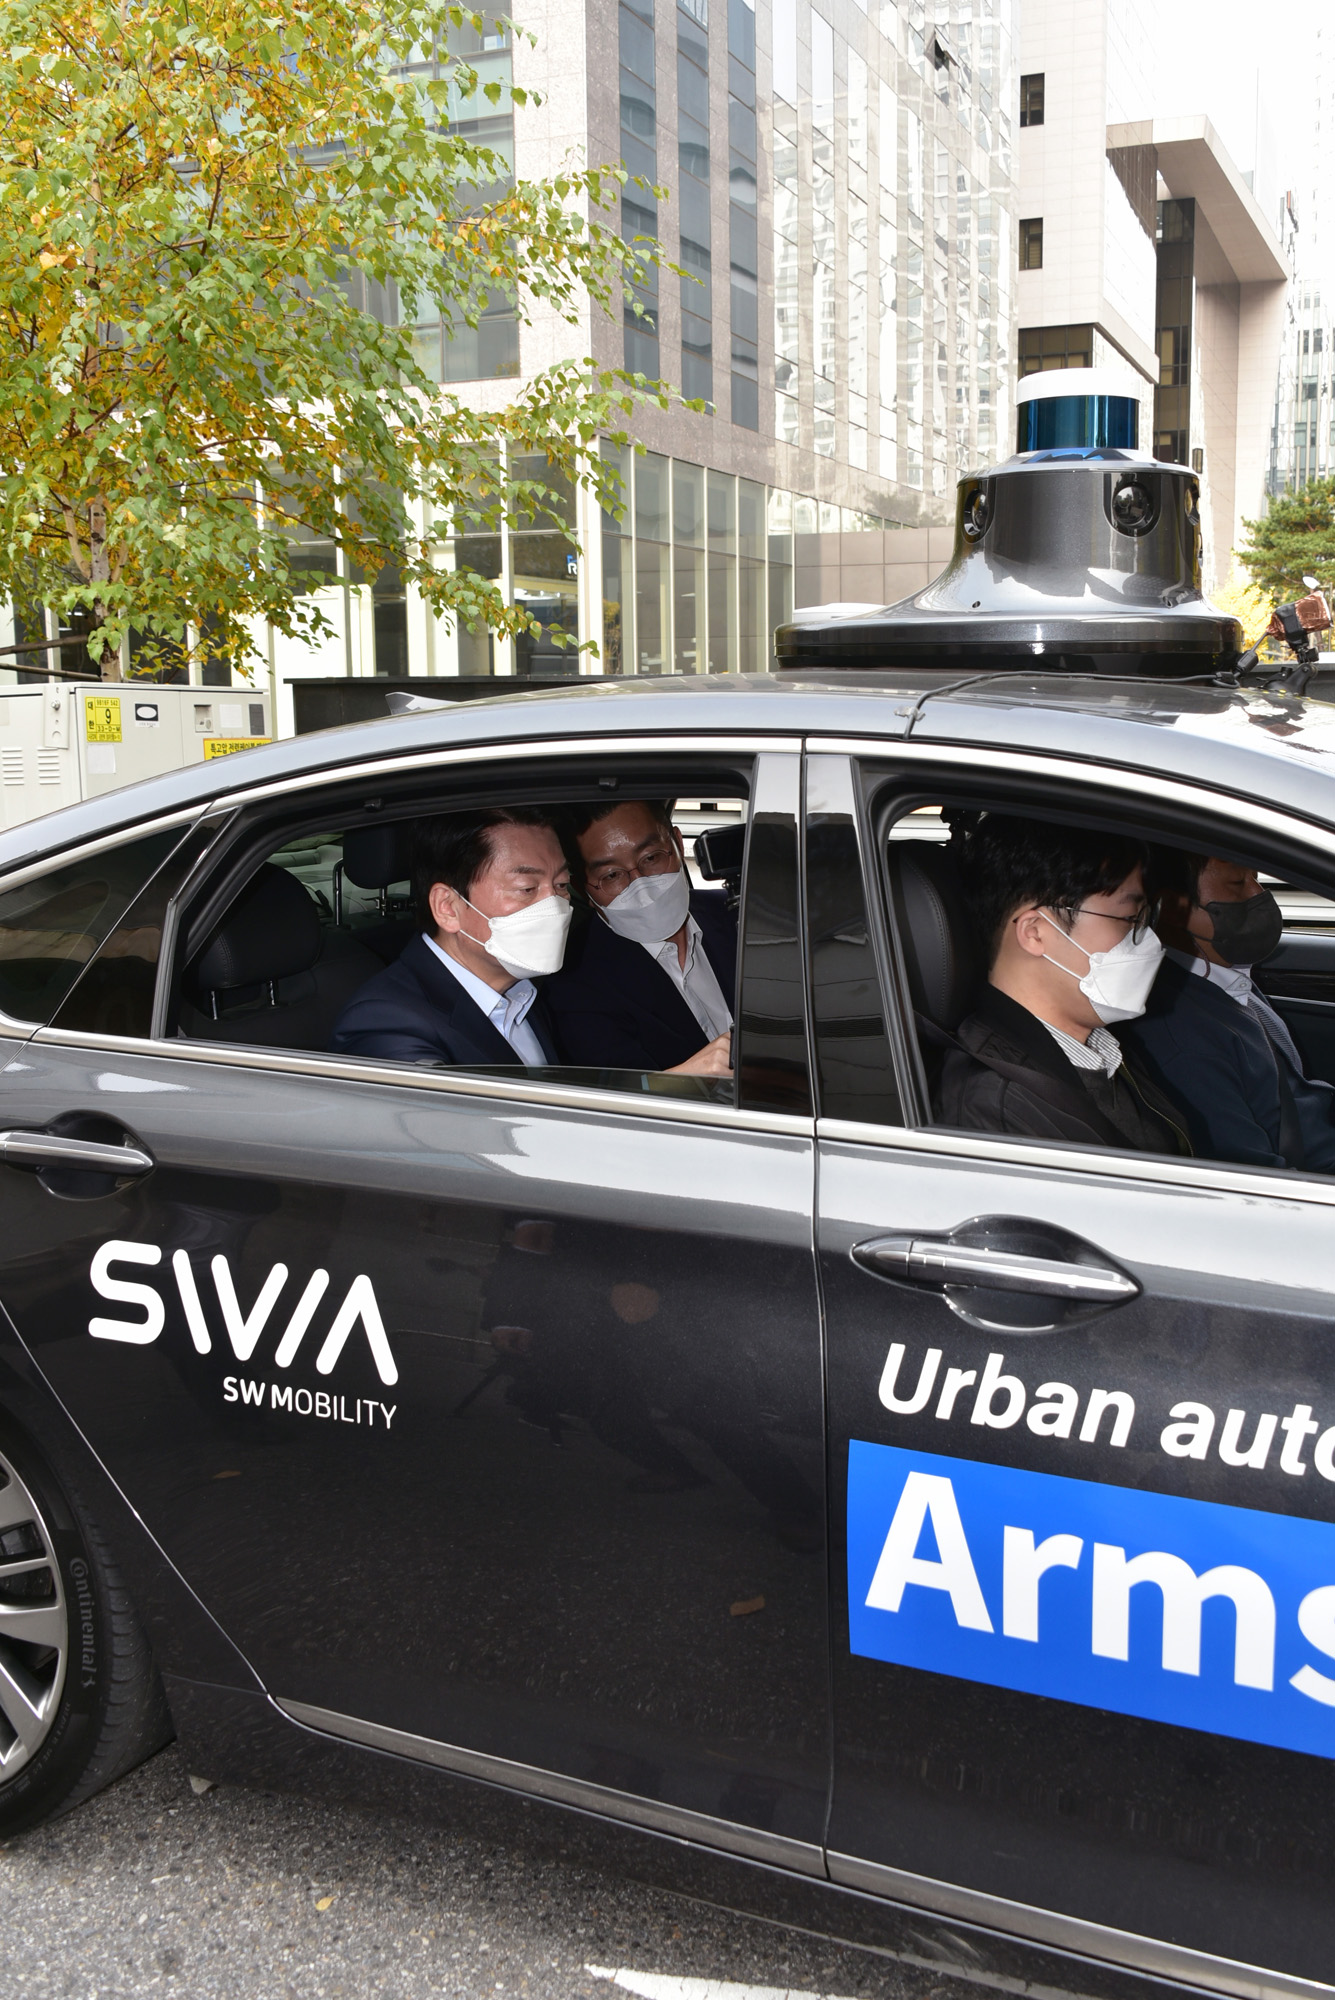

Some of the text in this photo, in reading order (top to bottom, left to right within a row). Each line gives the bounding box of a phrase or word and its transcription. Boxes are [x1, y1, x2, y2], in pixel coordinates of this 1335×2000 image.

[105, 708, 111, 724] 9
[211, 743, 227, 754] 특고압
[223, 1376, 397, 1429] SW MOBILITY
[878, 1342, 1135, 1447] Urban
[69, 1557, 97, 1672] Continental
